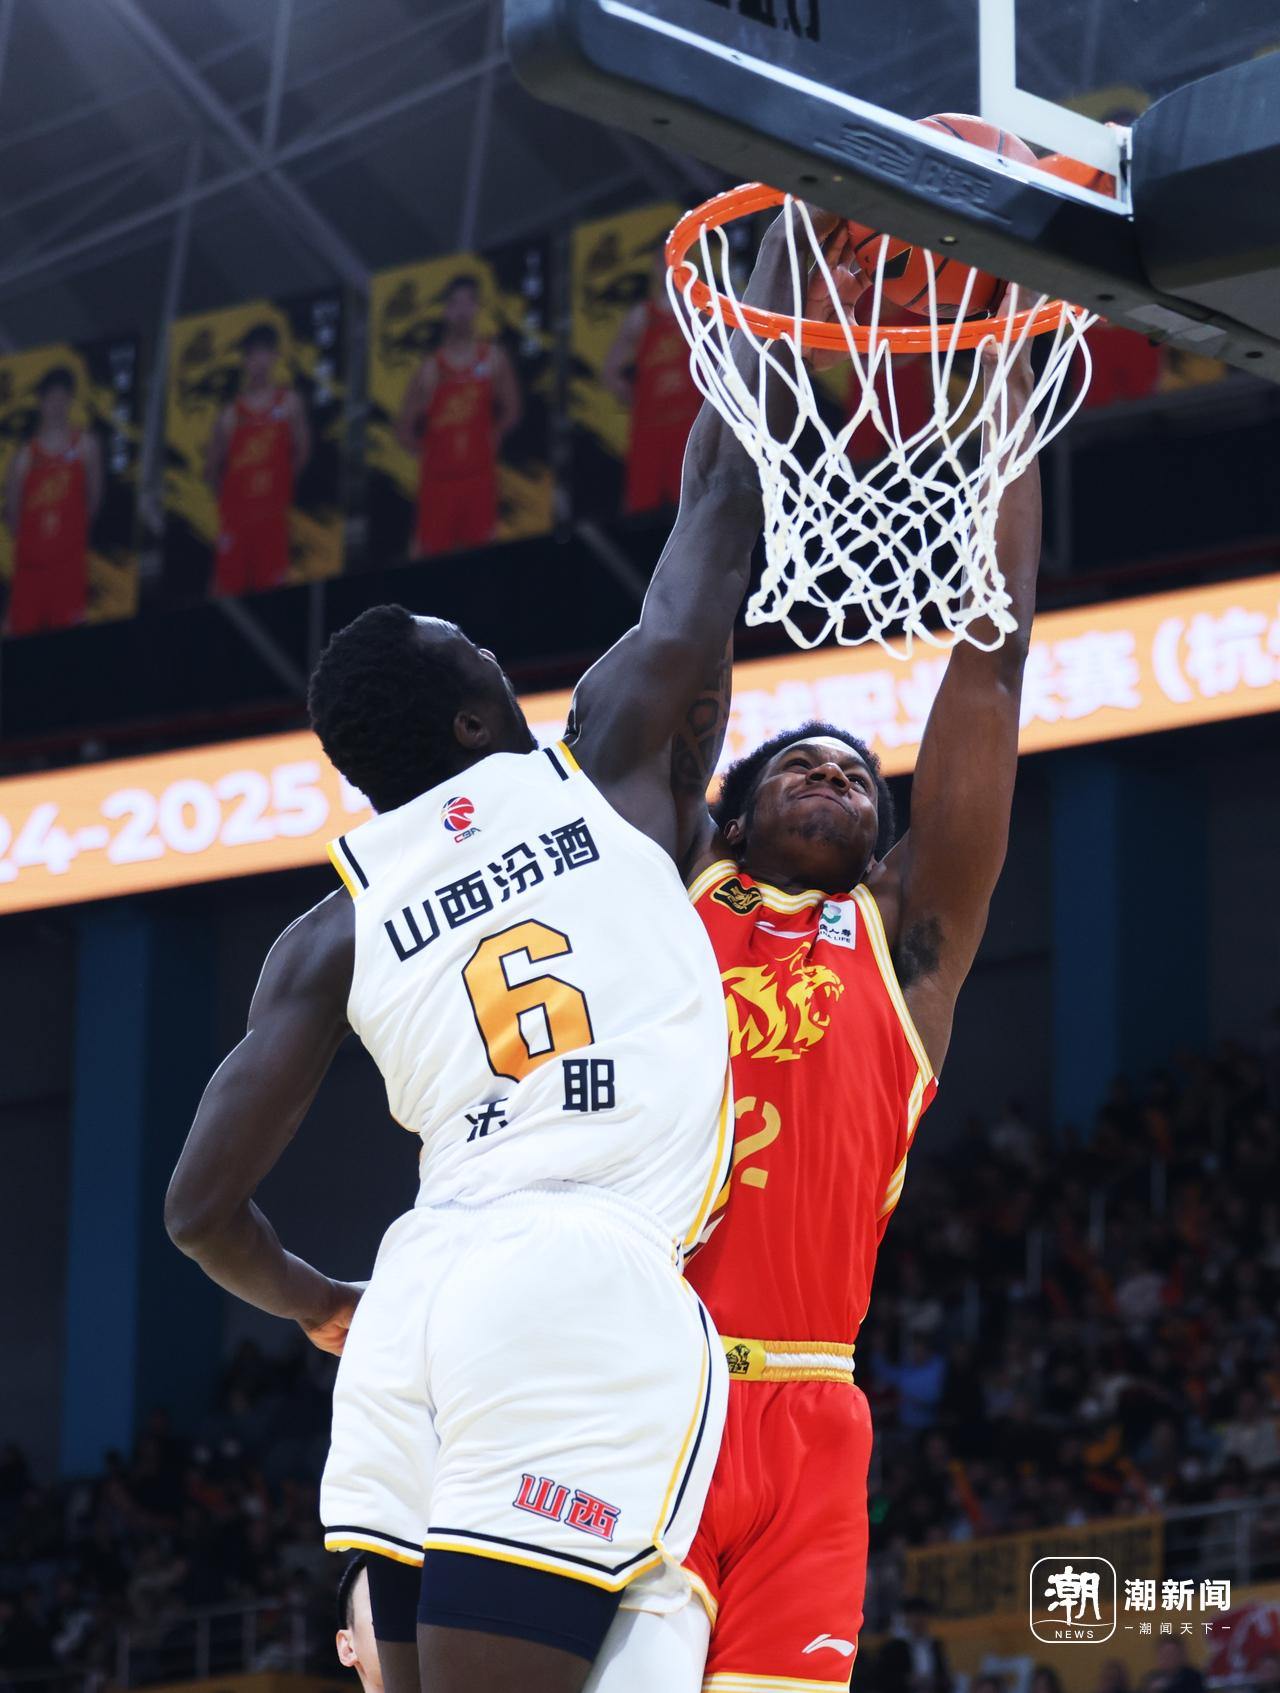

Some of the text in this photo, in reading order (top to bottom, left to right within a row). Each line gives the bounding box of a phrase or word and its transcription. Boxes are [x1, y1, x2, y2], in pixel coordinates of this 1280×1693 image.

[0, 761, 330, 884] 4-2025
[384, 817, 601, 962] 山西汾酒
[461, 918, 595, 1084] 6
[513, 1473, 622, 1542] 山西
